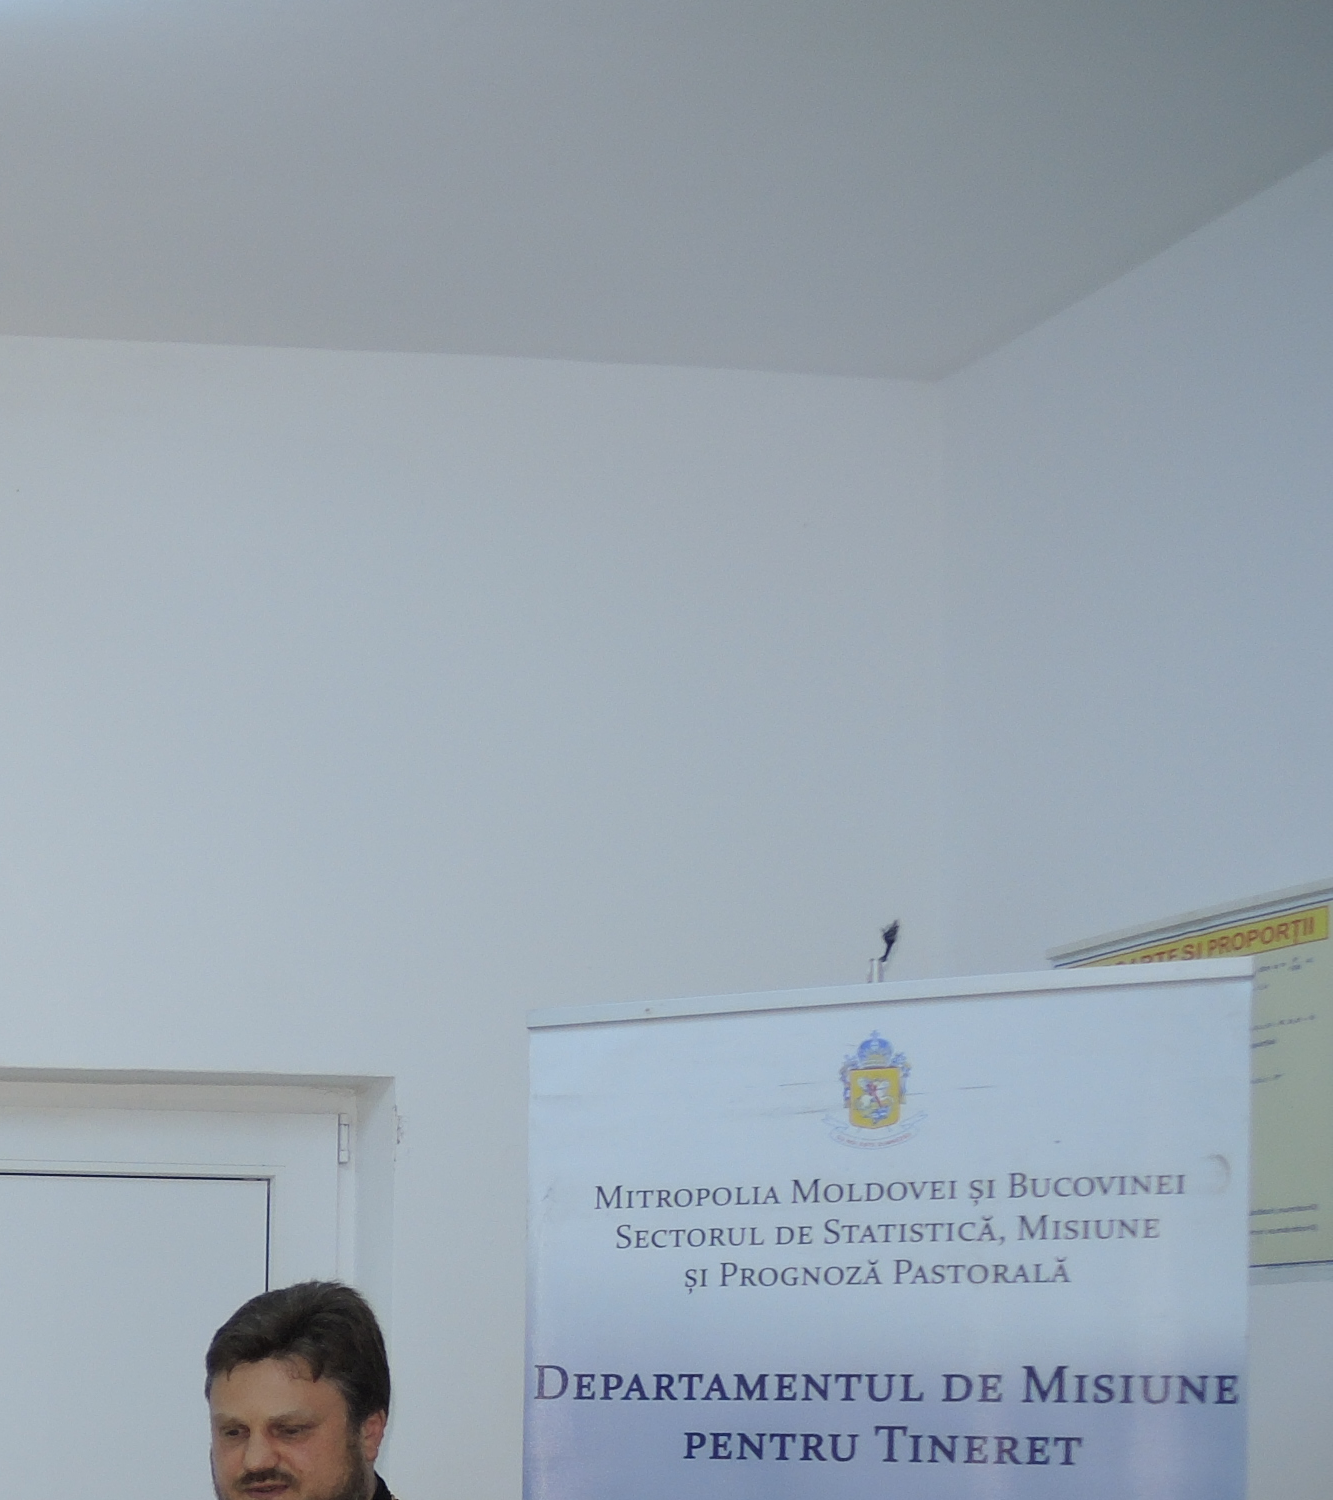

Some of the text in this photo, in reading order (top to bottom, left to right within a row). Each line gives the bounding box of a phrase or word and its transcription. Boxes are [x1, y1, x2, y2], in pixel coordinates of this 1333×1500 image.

[595, 1173, 1185, 1209] MITROPOLIA MOLDOVEI ȘI BUCOVINEI
[617, 1215, 1159, 1248] SECTORUL DE STATISTICĂ, MISIUNE
[685, 1259, 1071, 1294] ȘI PROGNOZĂ PASTORALĂ
[535, 1365, 1238, 1404] DEPARTAMENTUL DE MISIUNE
[683, 1426, 1082, 1465] PENTRU TINERET
